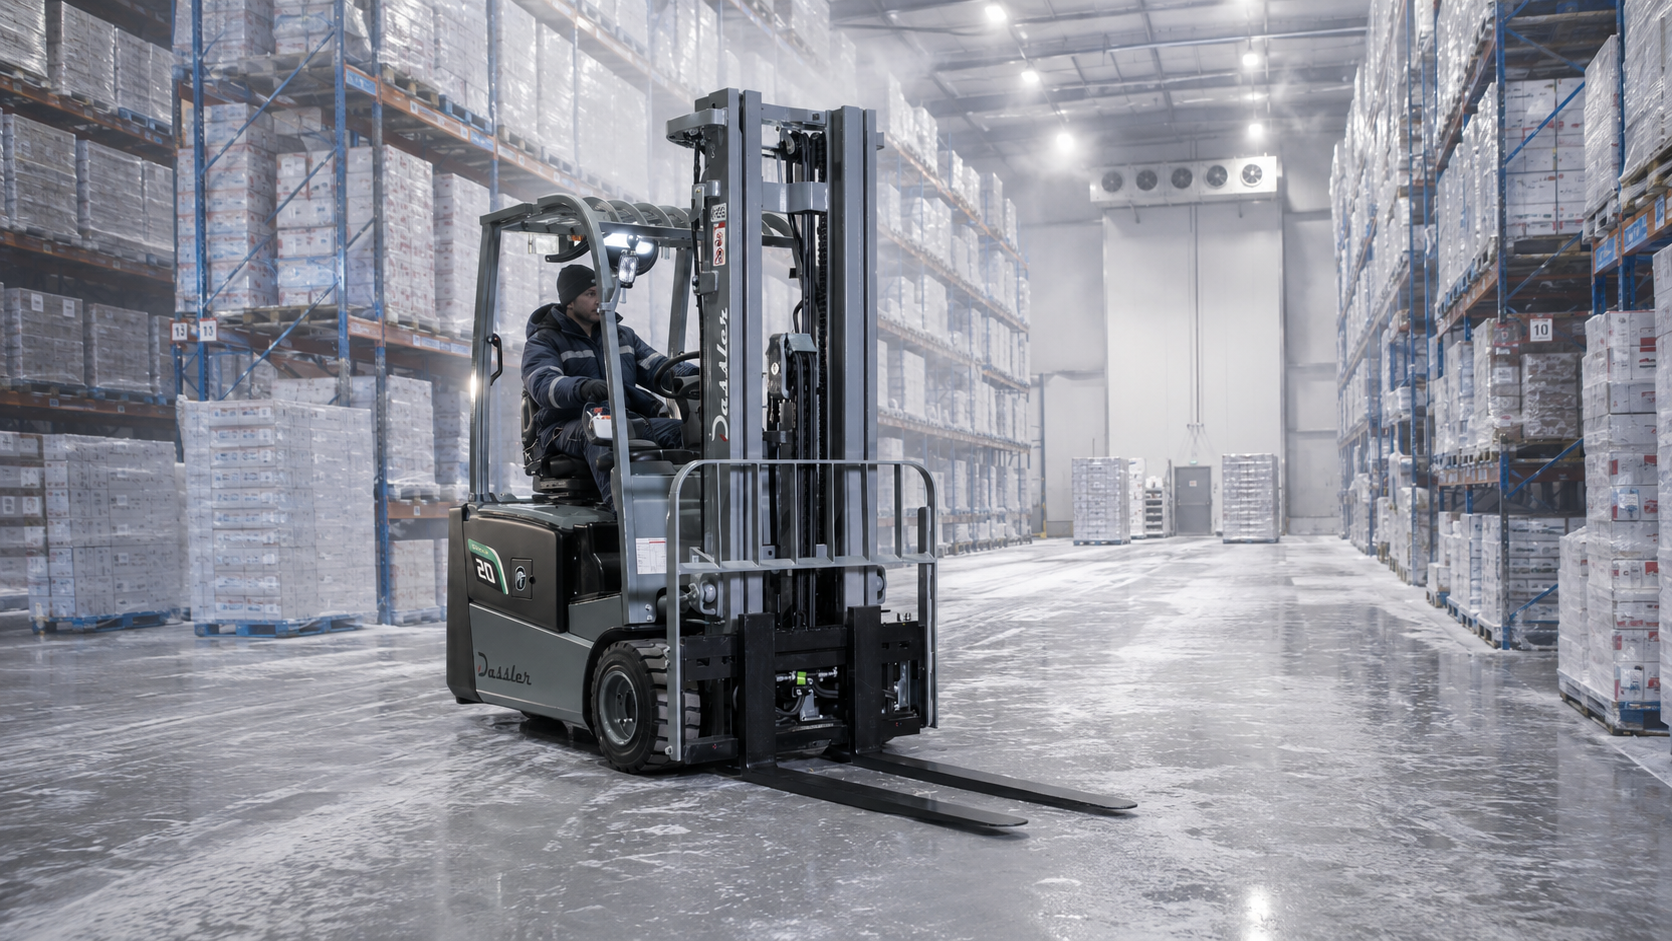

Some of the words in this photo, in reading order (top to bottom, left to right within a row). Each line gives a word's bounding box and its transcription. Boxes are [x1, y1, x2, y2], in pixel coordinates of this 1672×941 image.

[1533, 324, 1549, 336] 10
[711, 307, 729, 442] Dassler
[475, 558, 496, 584] 20
[477, 651, 532, 686] Dassler
